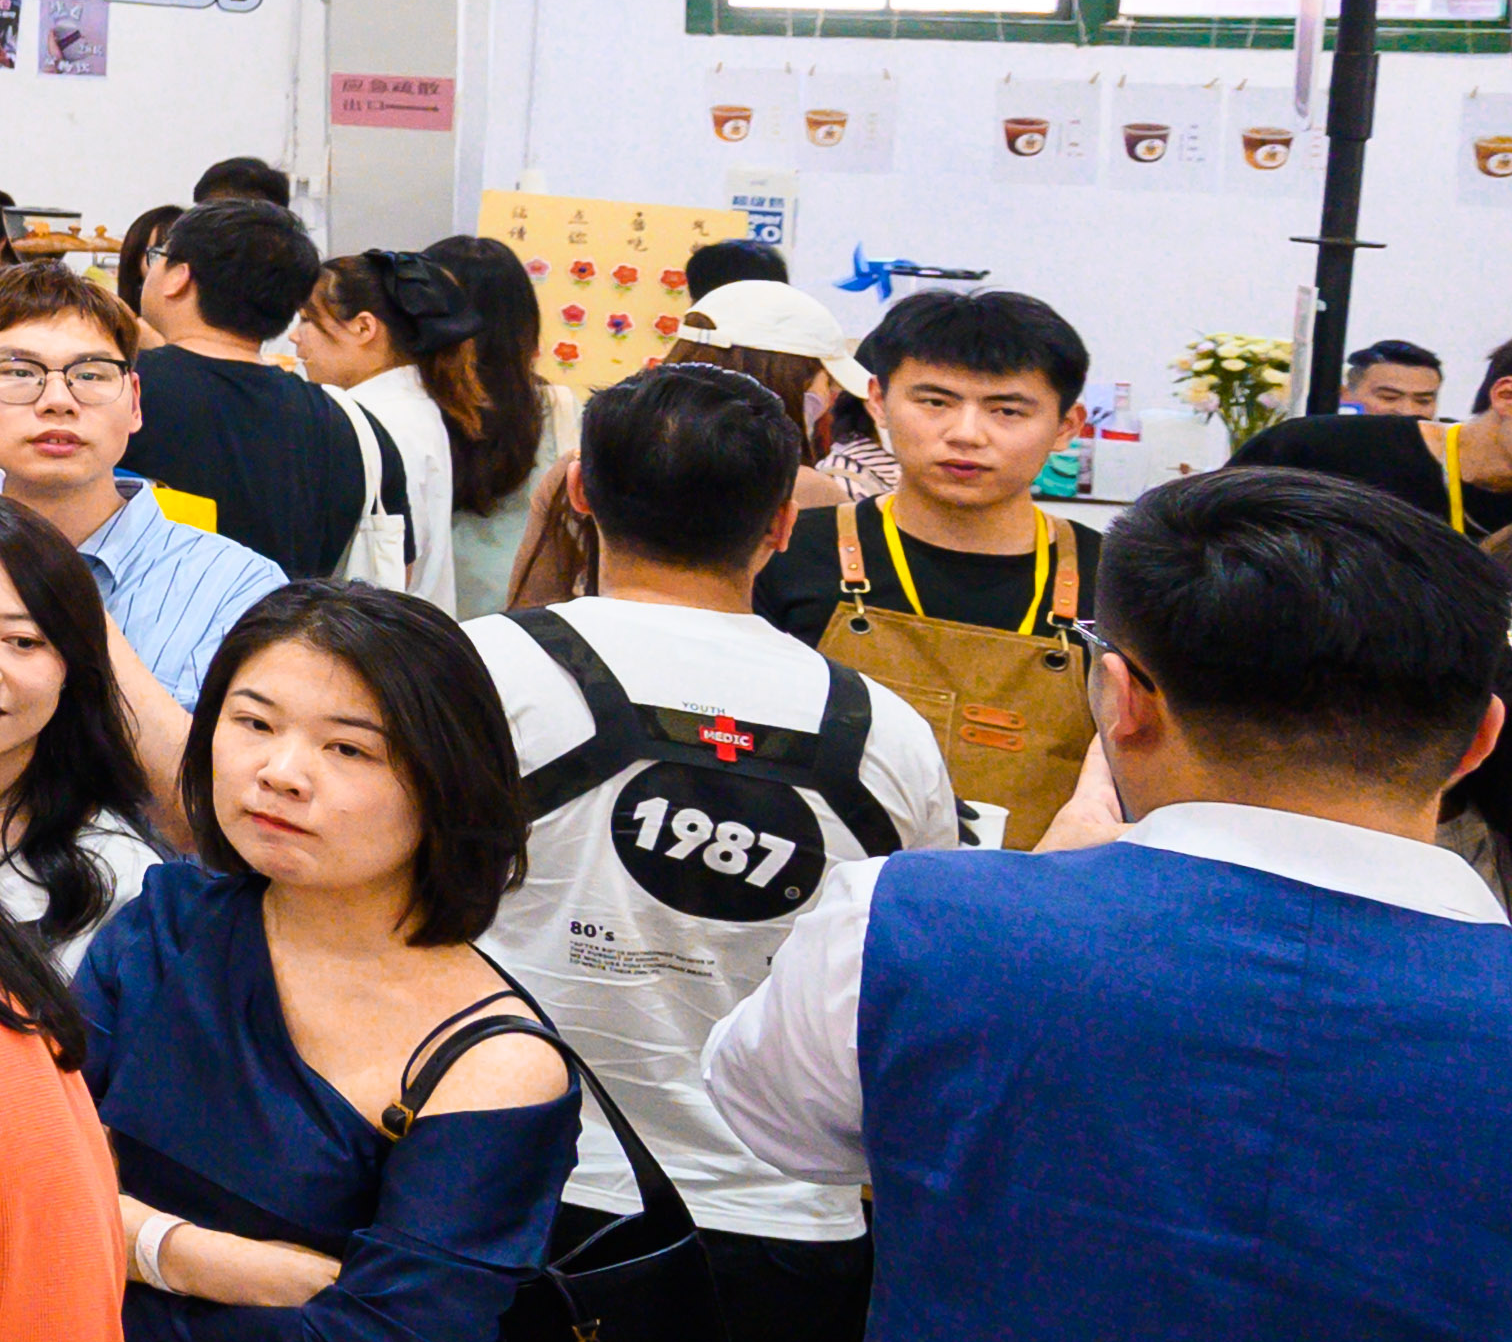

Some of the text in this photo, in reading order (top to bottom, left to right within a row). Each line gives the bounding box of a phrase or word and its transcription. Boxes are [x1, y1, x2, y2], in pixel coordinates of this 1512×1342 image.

[682, 701, 726, 716] YOUTH
[703, 729, 751, 747] MEDIC
[632, 796, 797, 889] 1987
[570, 920, 615, 942] 80's
